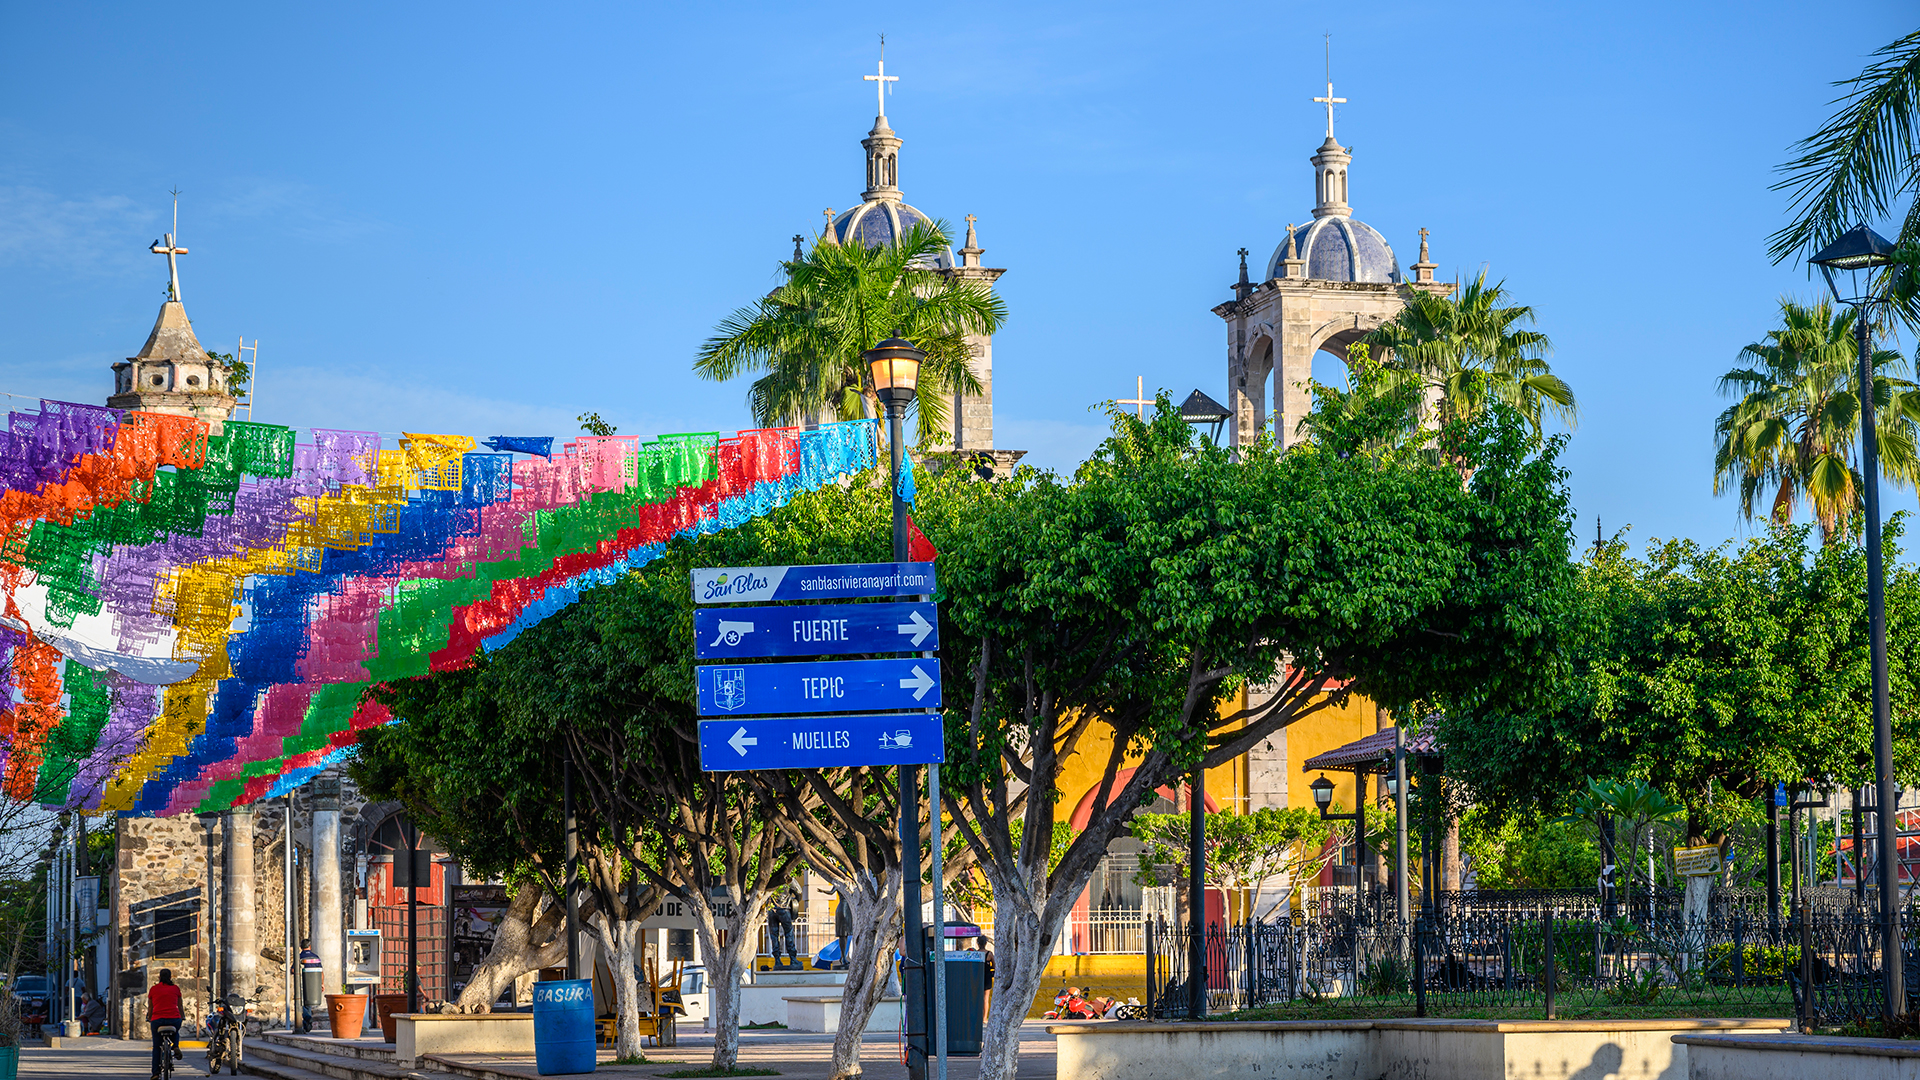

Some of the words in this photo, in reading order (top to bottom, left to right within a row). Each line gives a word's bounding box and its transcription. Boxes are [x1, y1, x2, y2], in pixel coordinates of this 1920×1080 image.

[704, 580, 733, 599] San
[733, 573, 768, 594] Blas
[800, 573, 924, 591] sanblasrivieranayarit.com
[793, 619, 849, 642] FUERTE
[802, 676, 844, 699] TEPIC
[792, 730, 850, 750] MUELLES
[667, 902, 683, 916] DE
[537, 987, 592, 1003] BASURA
